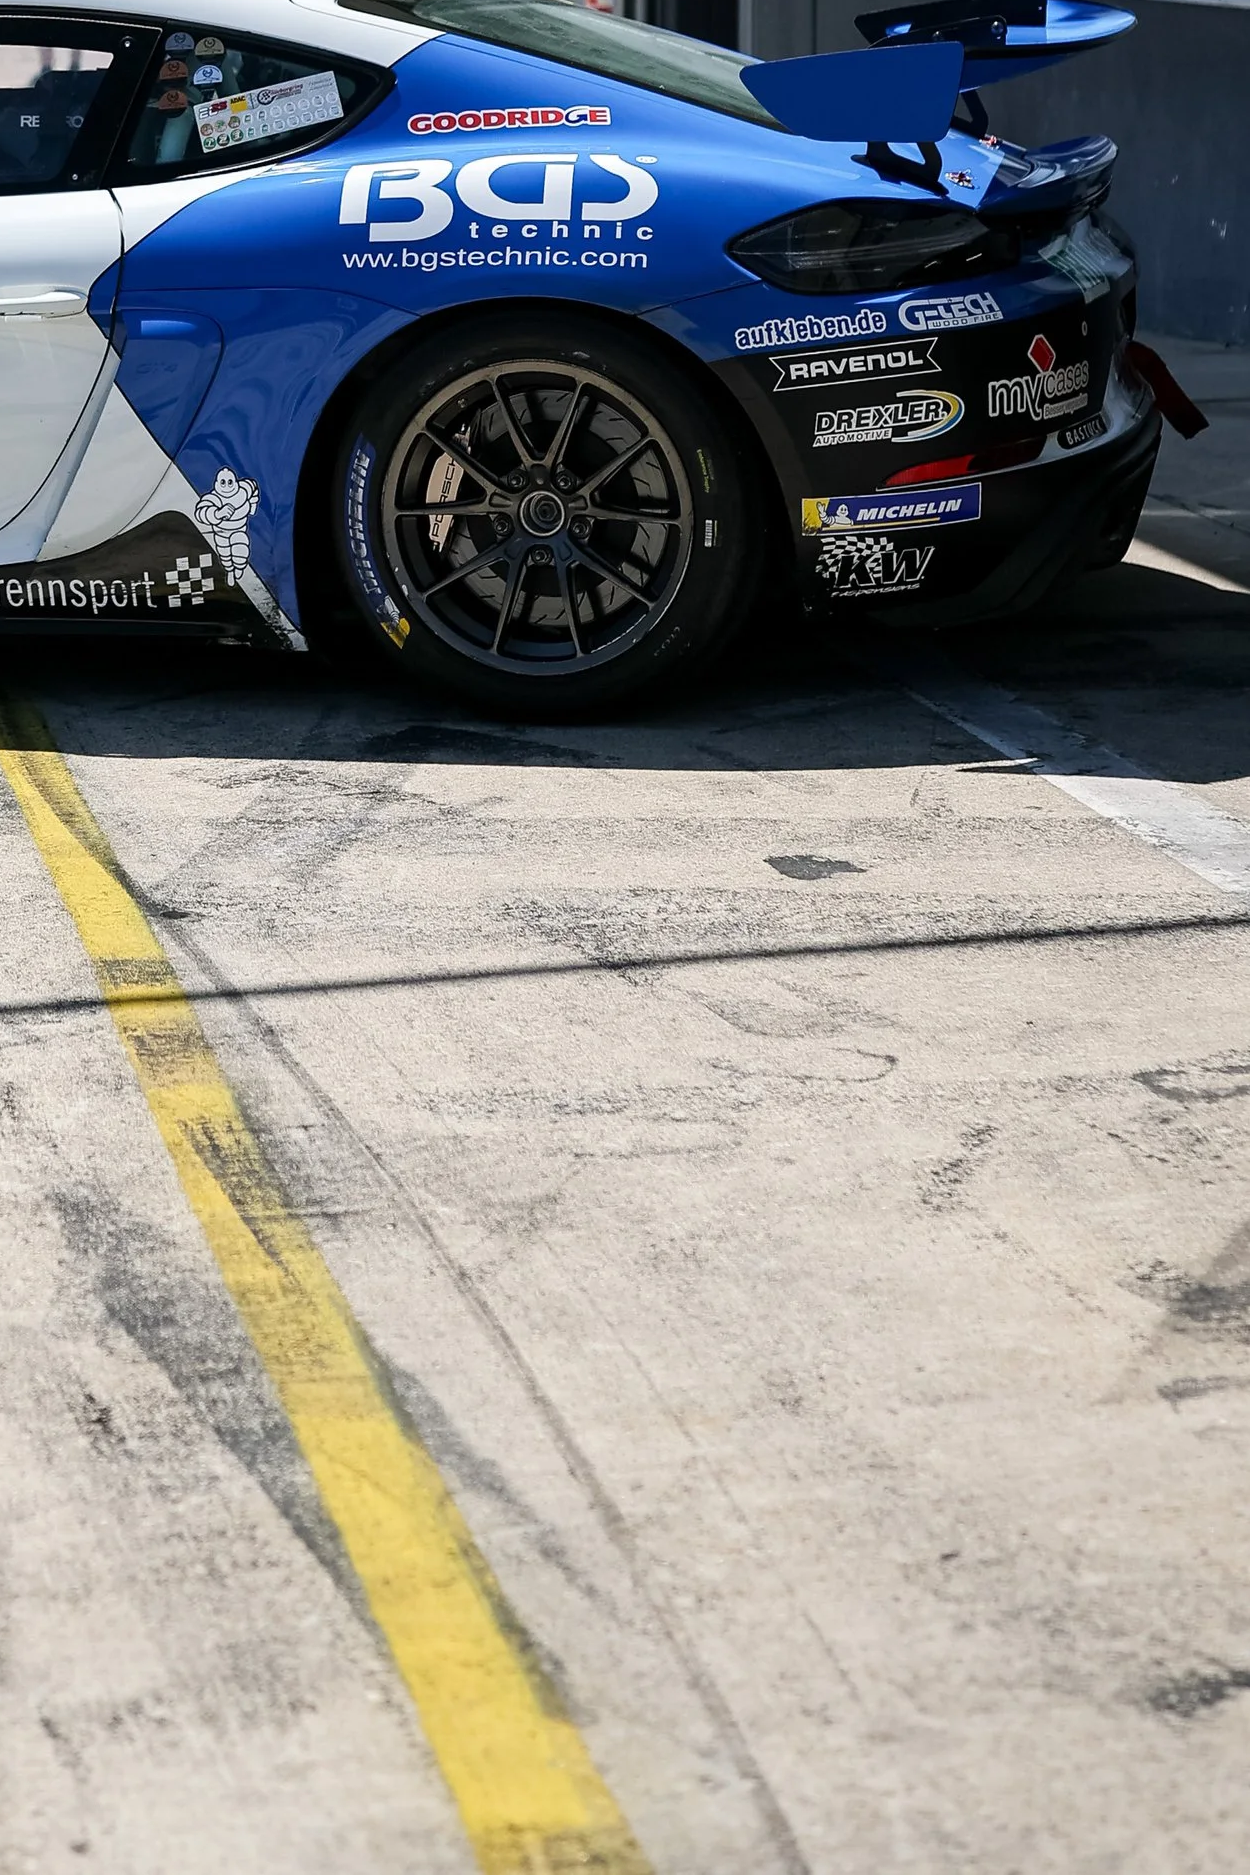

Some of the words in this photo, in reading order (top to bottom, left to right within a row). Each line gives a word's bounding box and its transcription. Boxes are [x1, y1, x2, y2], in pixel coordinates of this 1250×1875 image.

[409, 106, 610, 134] GOODRIDGE
[469, 220, 655, 241] technic
[735, 308, 887, 349] aufkleben.de
[932, 318, 969, 328] WOOD
[973, 313, 1000, 324] FIRE
[789, 350, 924, 380] RAVENOL
[814, 400, 948, 434] DREXLER
[812, 428, 893, 448] AUTOMOTIVE
[856, 498, 963, 522] MICHELIN
[833, 545, 936, 589] KW
